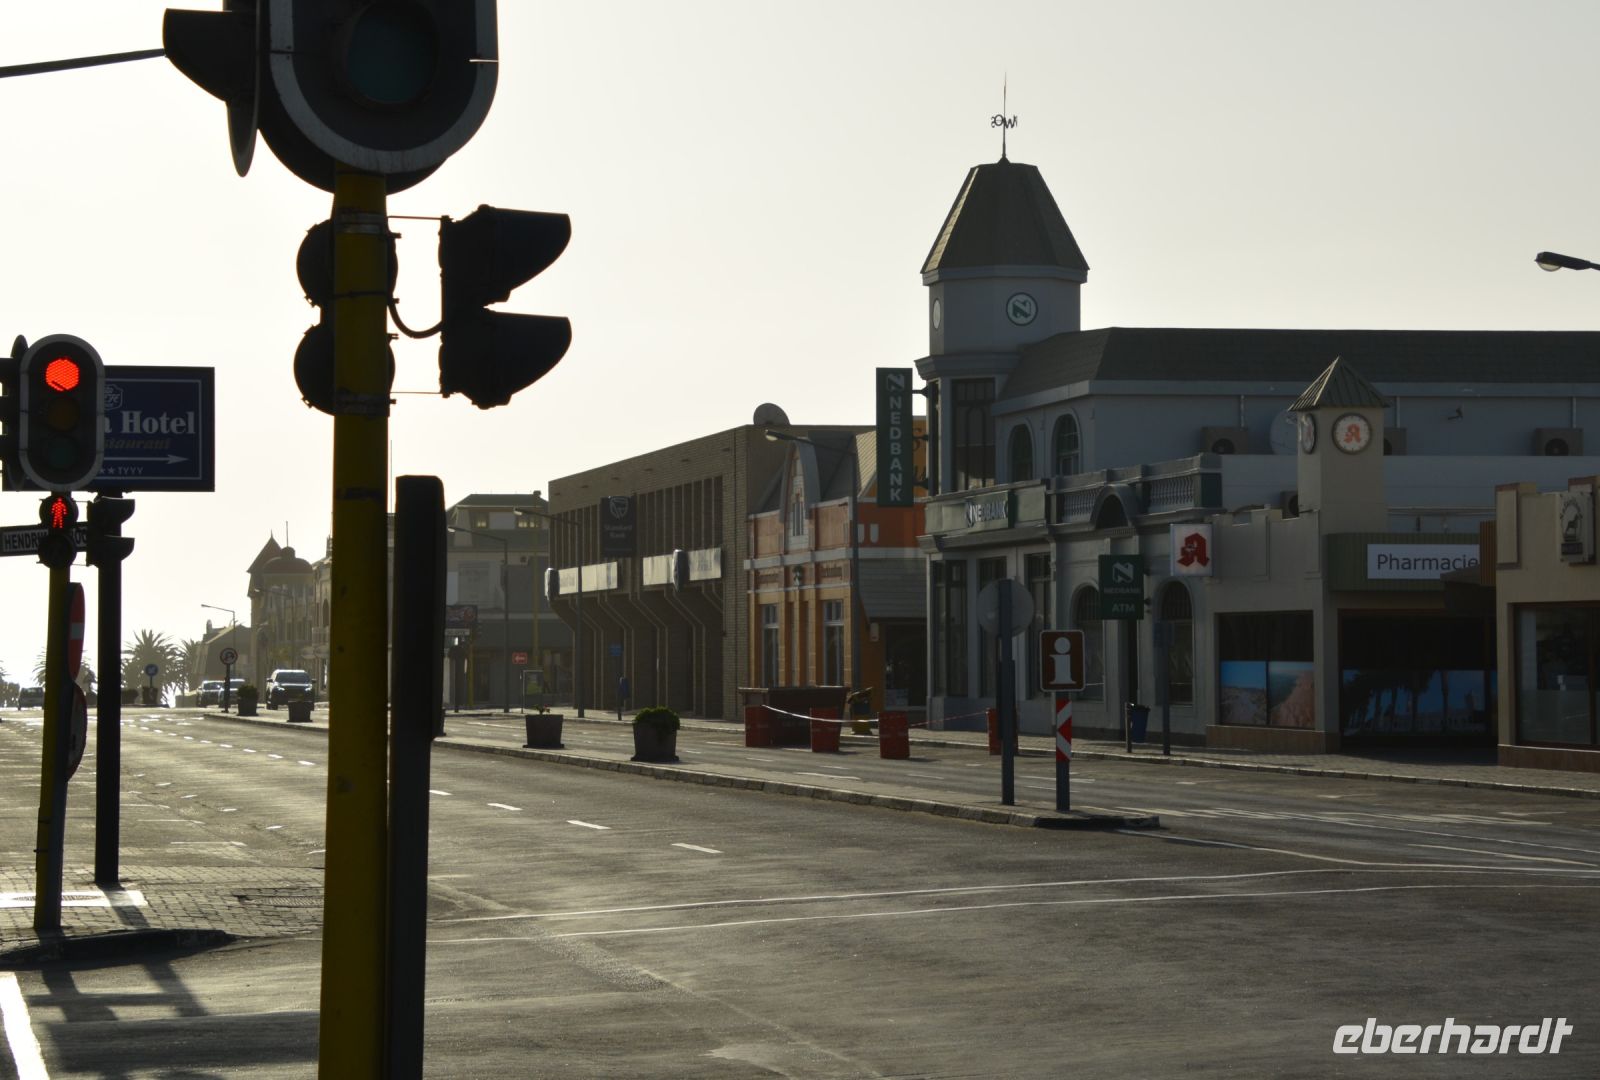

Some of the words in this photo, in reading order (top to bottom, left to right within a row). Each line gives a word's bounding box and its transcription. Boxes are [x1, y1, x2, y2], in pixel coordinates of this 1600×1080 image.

[120, 410, 195, 434] Hotel
[104, 438, 171, 449] staurant
[889, 396, 902, 501] NEDBANK
[973, 500, 1006, 522] NEDBANK
[4, 529, 48, 550] HENDR
[1377, 553, 1478, 570] Pharmacie
[1112, 603, 1136, 614] ATM
